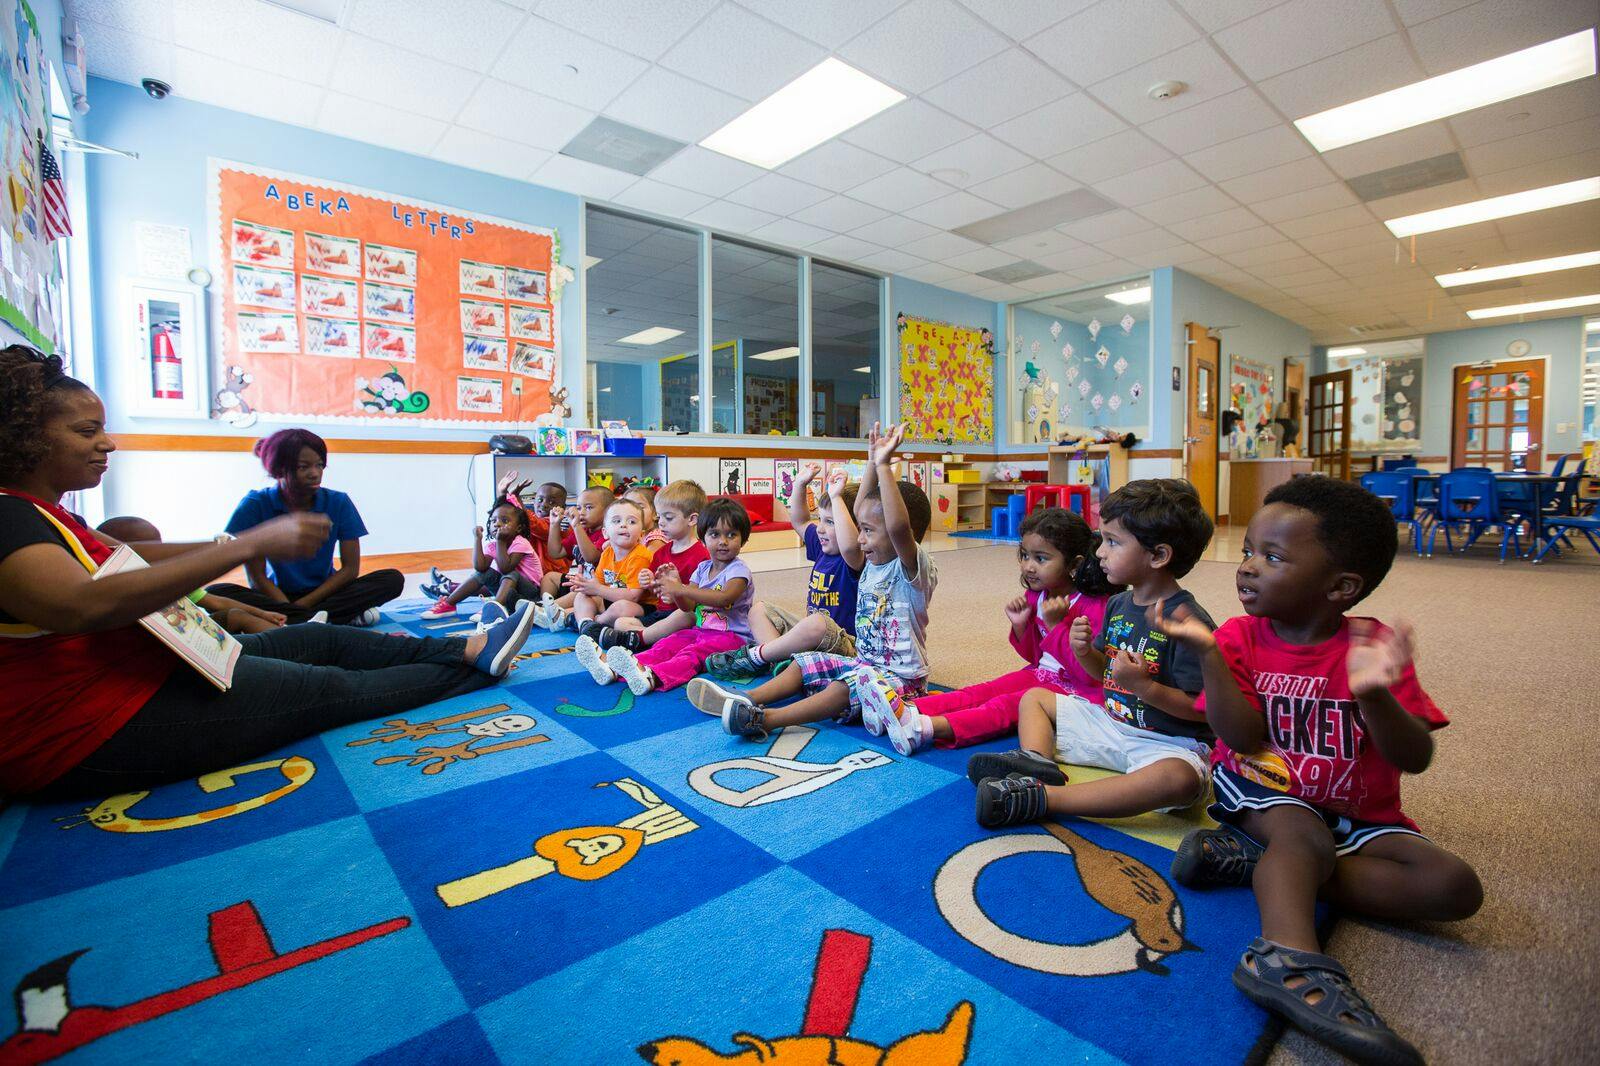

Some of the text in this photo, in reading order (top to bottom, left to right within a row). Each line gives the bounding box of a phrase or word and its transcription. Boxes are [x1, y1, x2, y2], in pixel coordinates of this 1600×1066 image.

[265, 184, 475, 239] ABEKA LETTERS
[916, 324, 944, 346] FREE
[1253, 670, 1328, 700] USTON
[1265, 695, 1364, 761] CKETS
